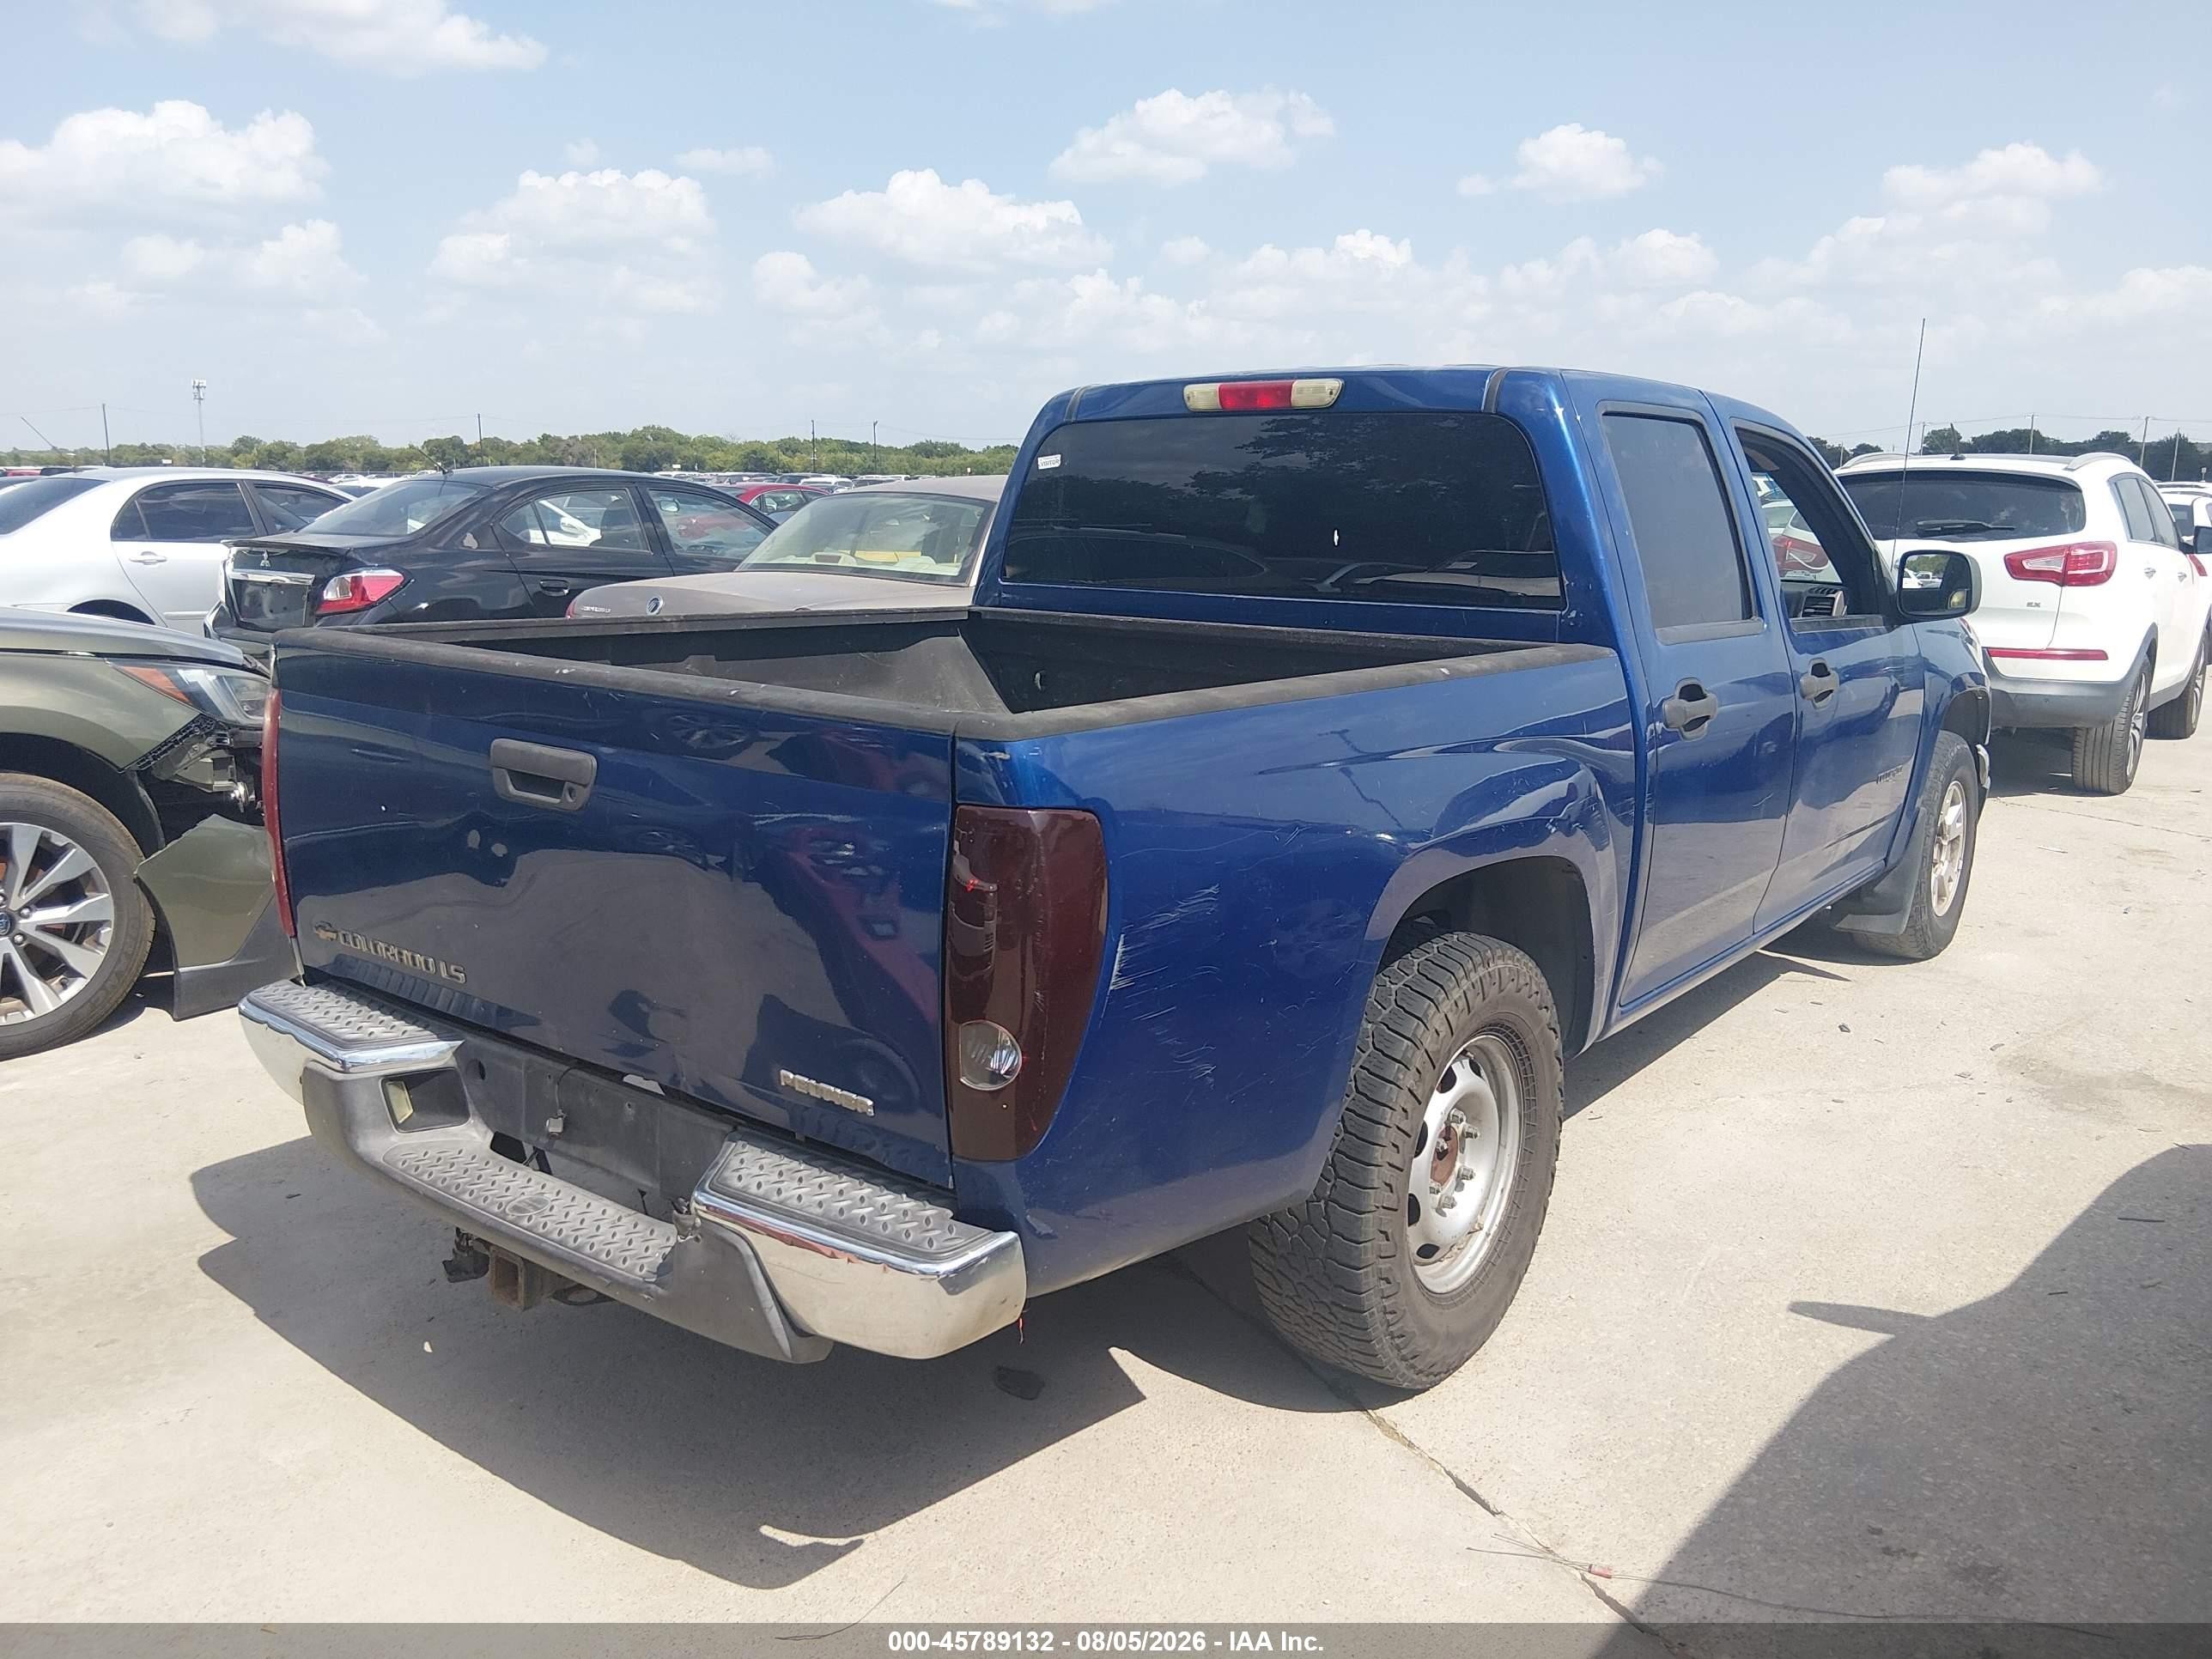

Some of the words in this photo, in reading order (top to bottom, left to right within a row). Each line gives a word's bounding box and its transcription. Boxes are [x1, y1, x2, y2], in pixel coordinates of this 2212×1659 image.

[1040, 459, 1060, 467] VISITOR
[338, 930, 436, 975] COLORADO
[439, 960, 467, 985] LS
